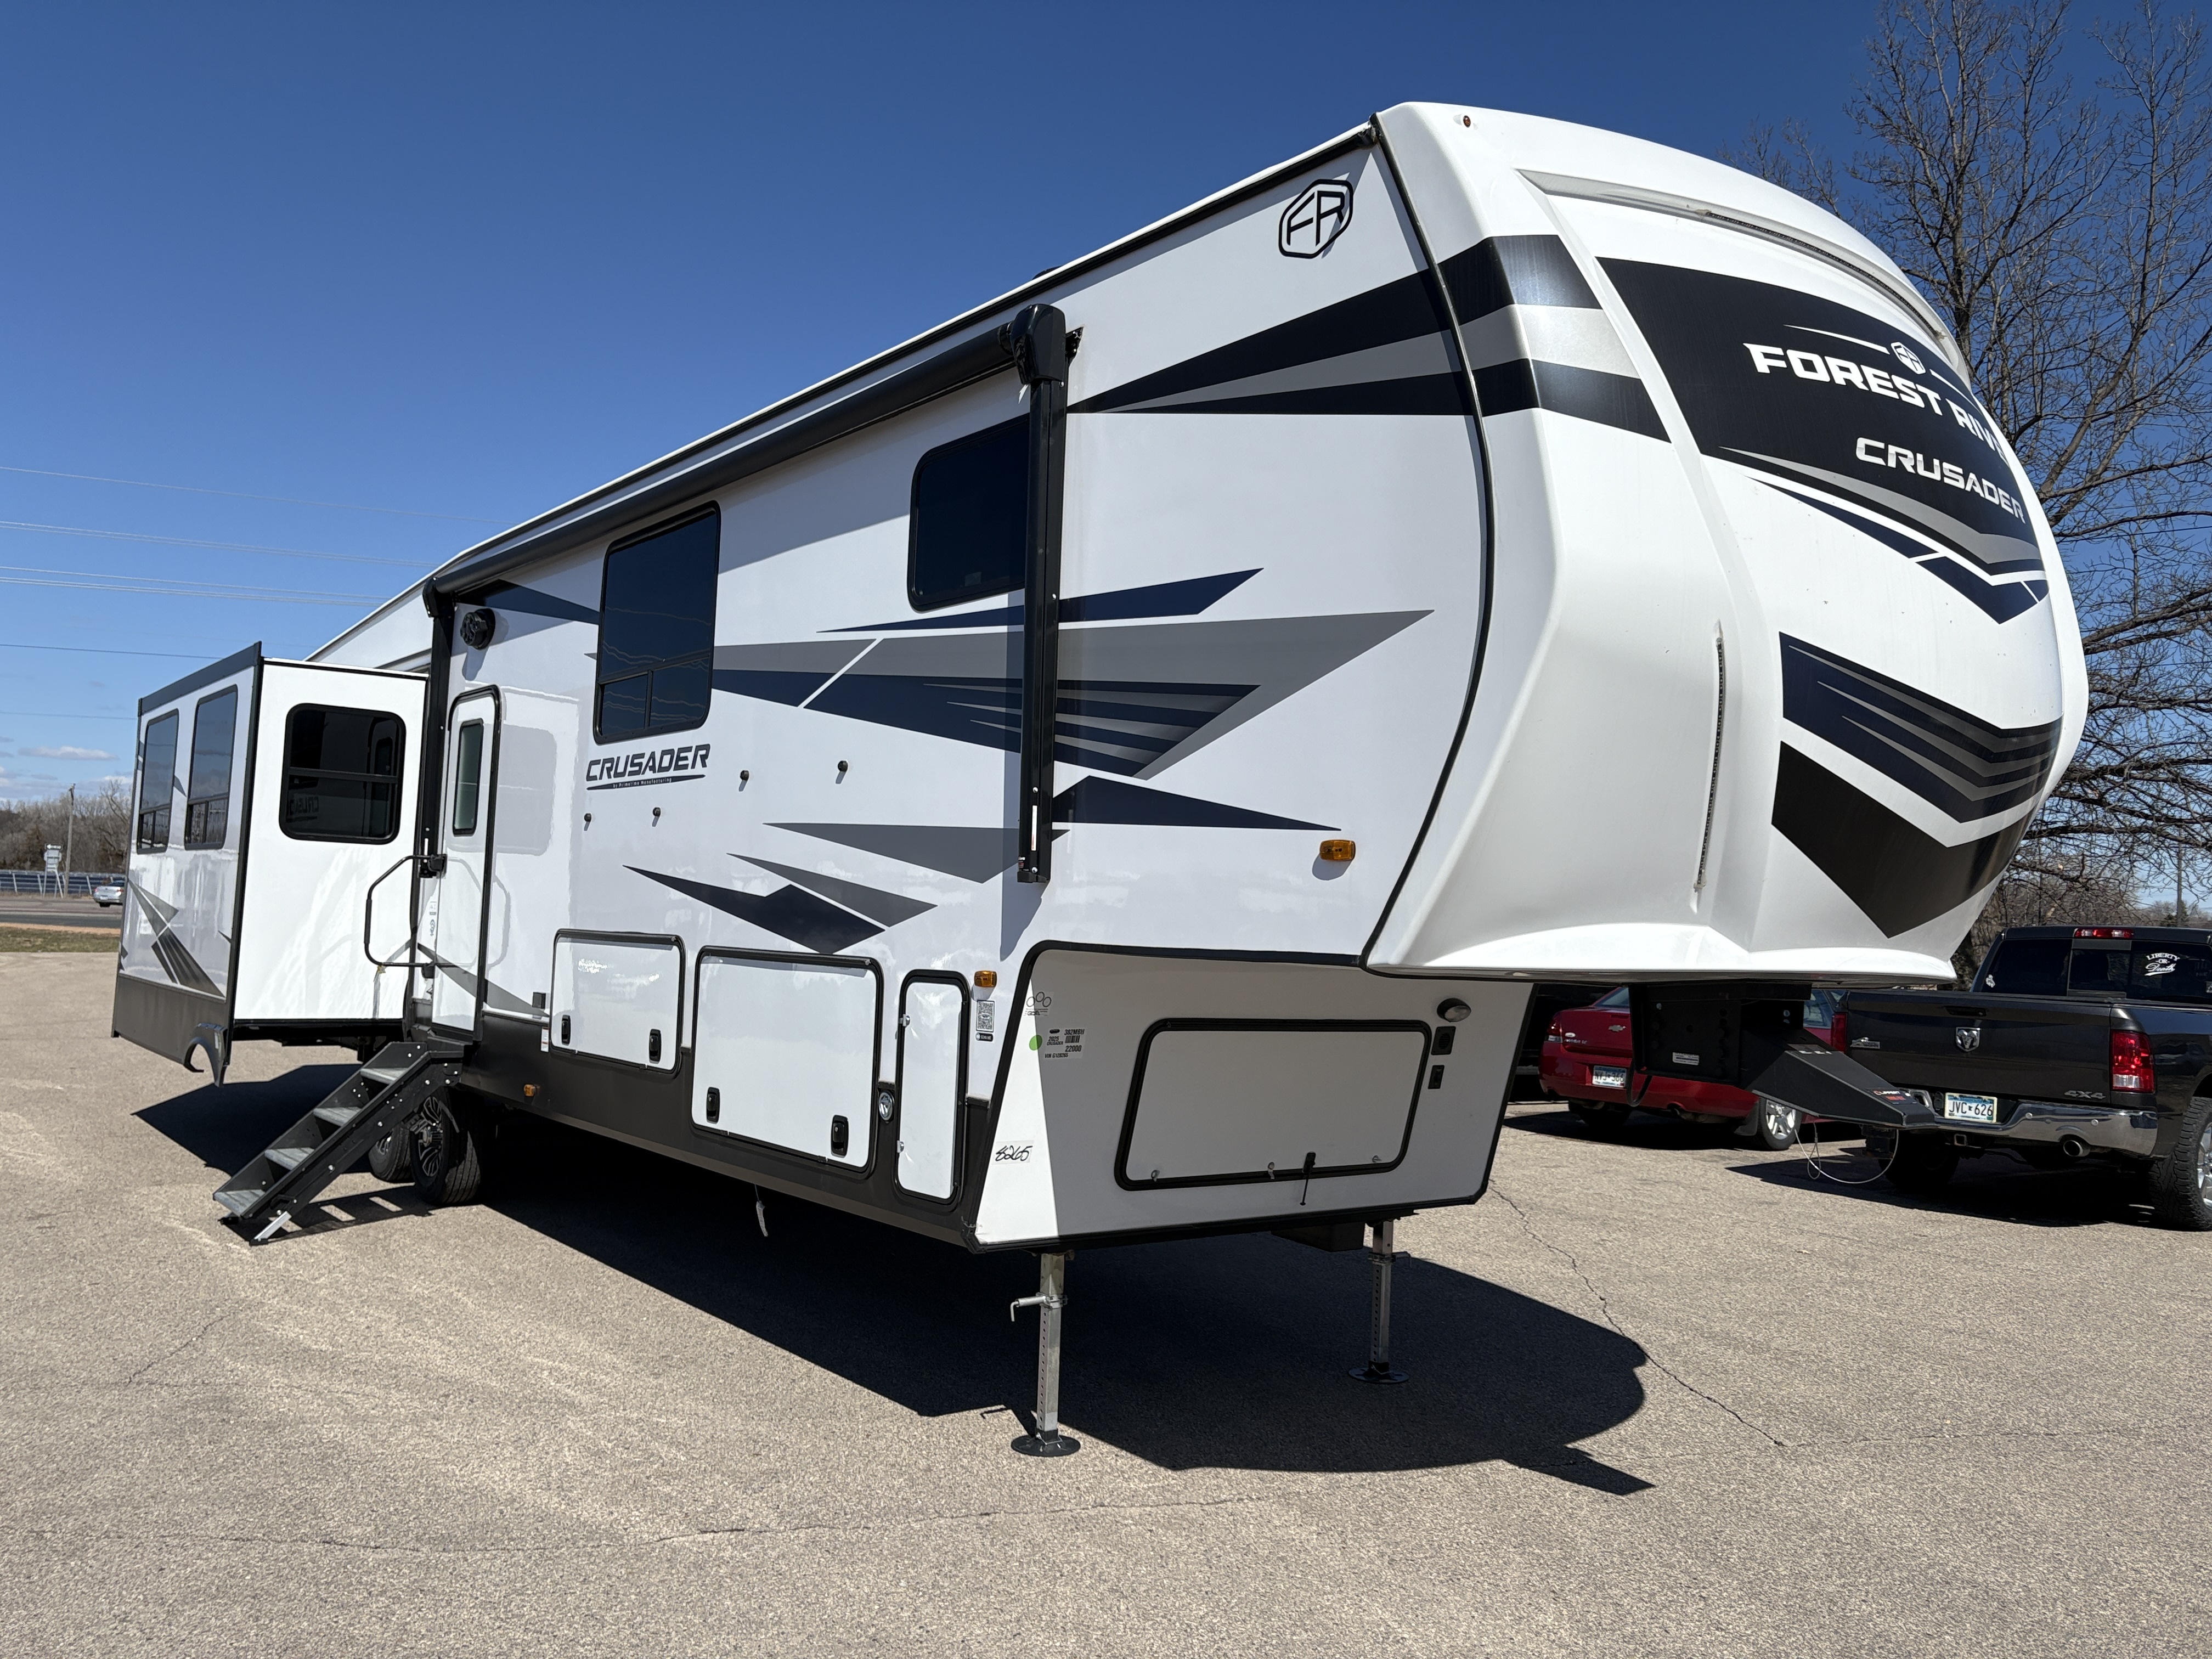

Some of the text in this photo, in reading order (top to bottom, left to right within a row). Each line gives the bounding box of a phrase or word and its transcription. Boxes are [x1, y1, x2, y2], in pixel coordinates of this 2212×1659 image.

[1743, 343, 1943, 416] FOREST
[1856, 437, 2026, 524] CRUSADER
[586, 743, 710, 782] CRUSADER
[2146, 952, 2180, 961] LIBERTY
[2145, 962, 2176, 973] Death
[1949, 1101, 1993, 1116] JVC 626
[995, 1145, 1033, 1161] 8265
